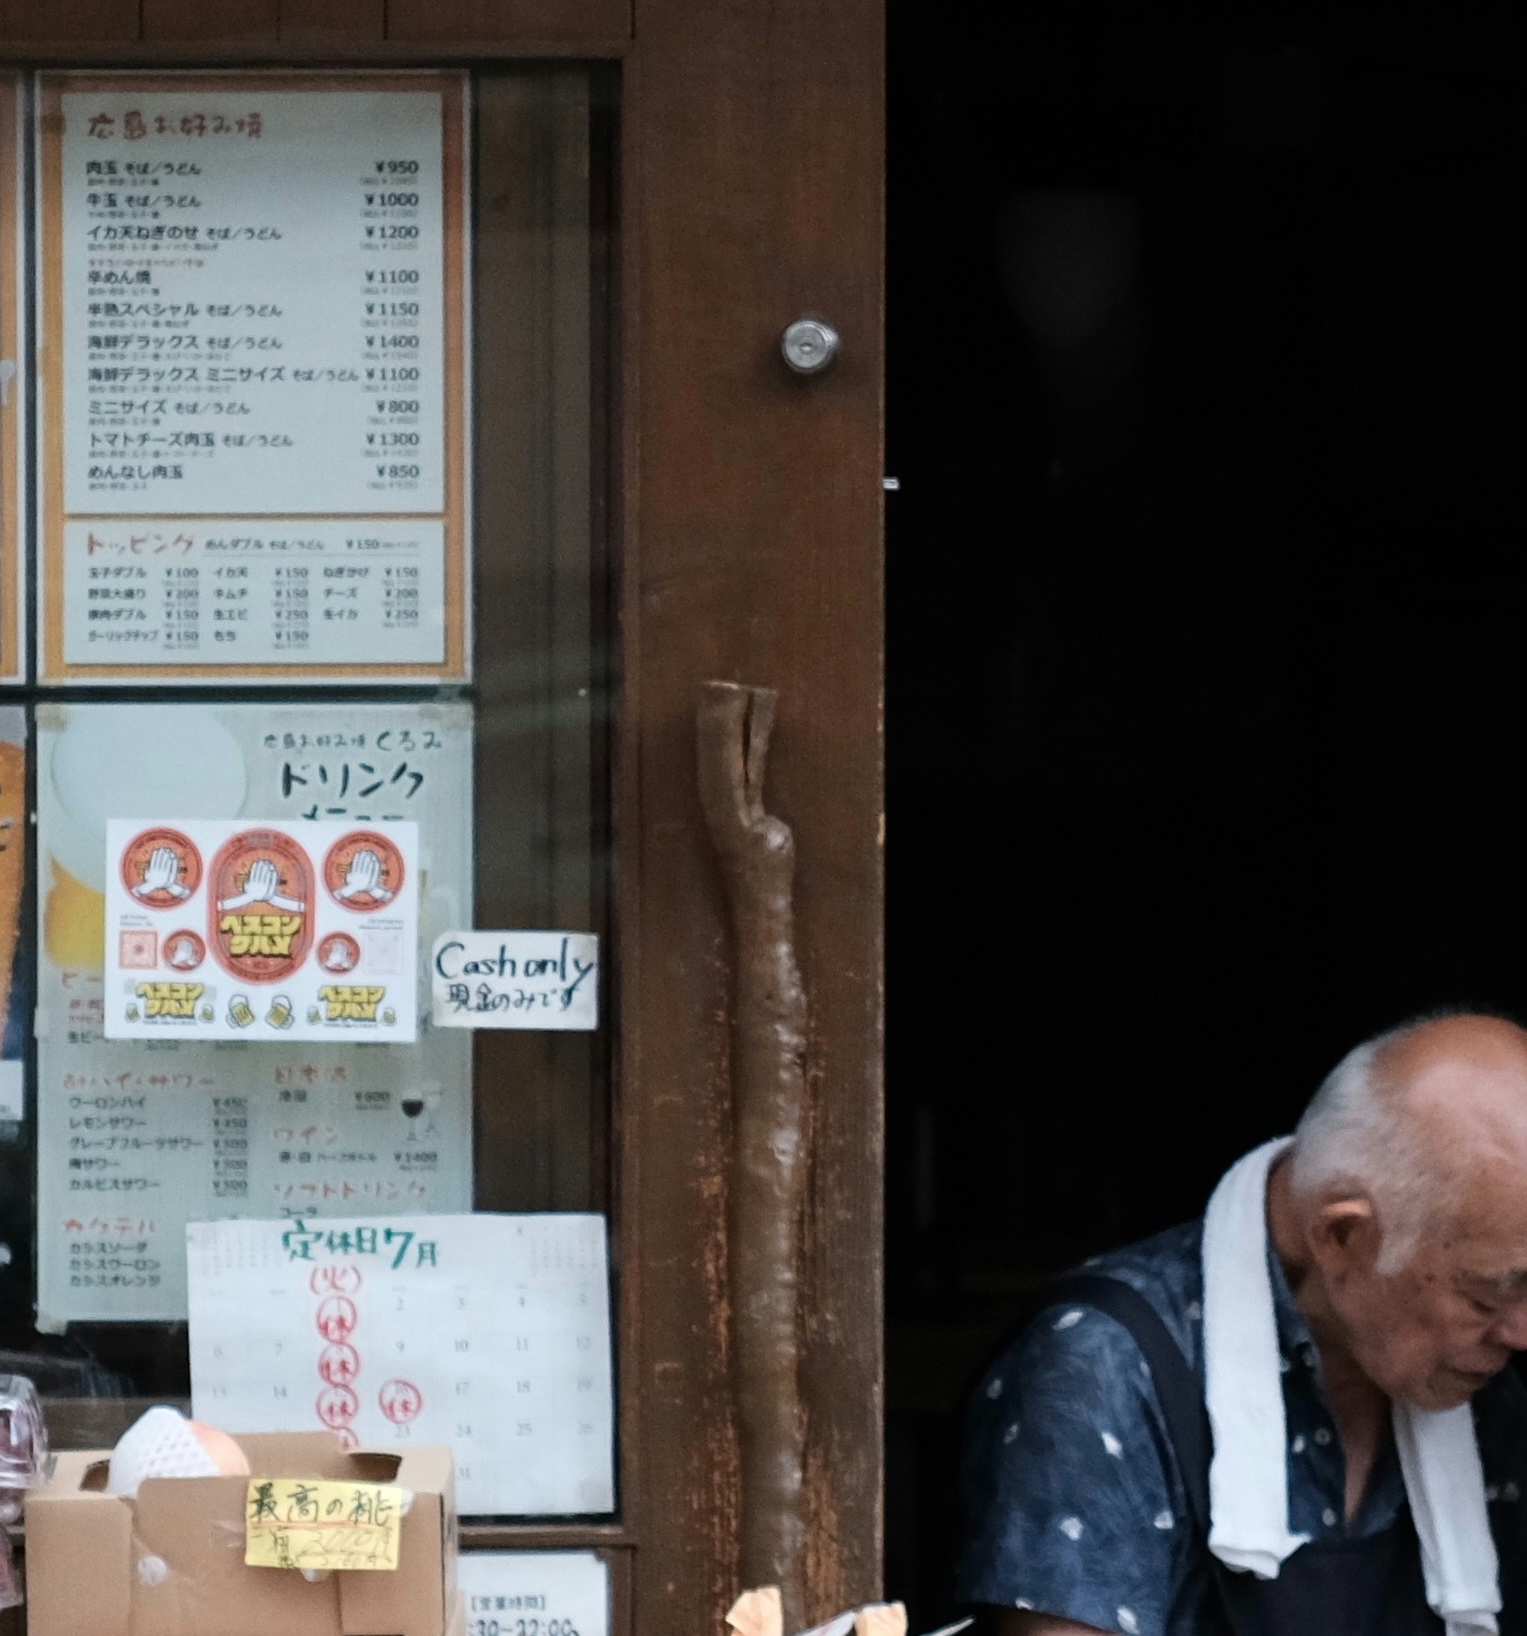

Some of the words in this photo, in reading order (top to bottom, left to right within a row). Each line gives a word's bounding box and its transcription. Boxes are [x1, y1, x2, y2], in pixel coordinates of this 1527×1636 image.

[375, 160, 419, 174] ¥950
[364, 193, 419, 207] ¥1000
[87, 226, 199, 240] イカ天ねぎのせ
[364, 225, 419, 240] ¥1200
[365, 270, 419, 284] ¥1100
[87, 302, 199, 317] 半熟スペシャル
[87, 335, 199, 350] 海鮮デラックス
[365, 335, 419, 349] ¥1400
[87, 367, 199, 382] 海鮮デラックス
[206, 368, 285, 382] ミニサイズ
[365, 368, 419, 382] ¥1100
[88, 400, 167, 415] ミニサイズ
[376, 400, 419, 414] ¥800
[89, 432, 216, 447] トマトチーズ肉玉
[365, 433, 419, 447] ¥1300
[88, 465, 183, 480] めんなし肉玉
[376, 465, 419, 479] ¥850
[281, 761, 424, 798] ドリンク
[435, 938, 520, 980] Cash
[523, 936, 595, 985] only
[446, 984, 576, 1012] 現金のみです
[69, 1117, 147, 1129] レモンサワー
[249, 1483, 392, 1527] 最高の桃
